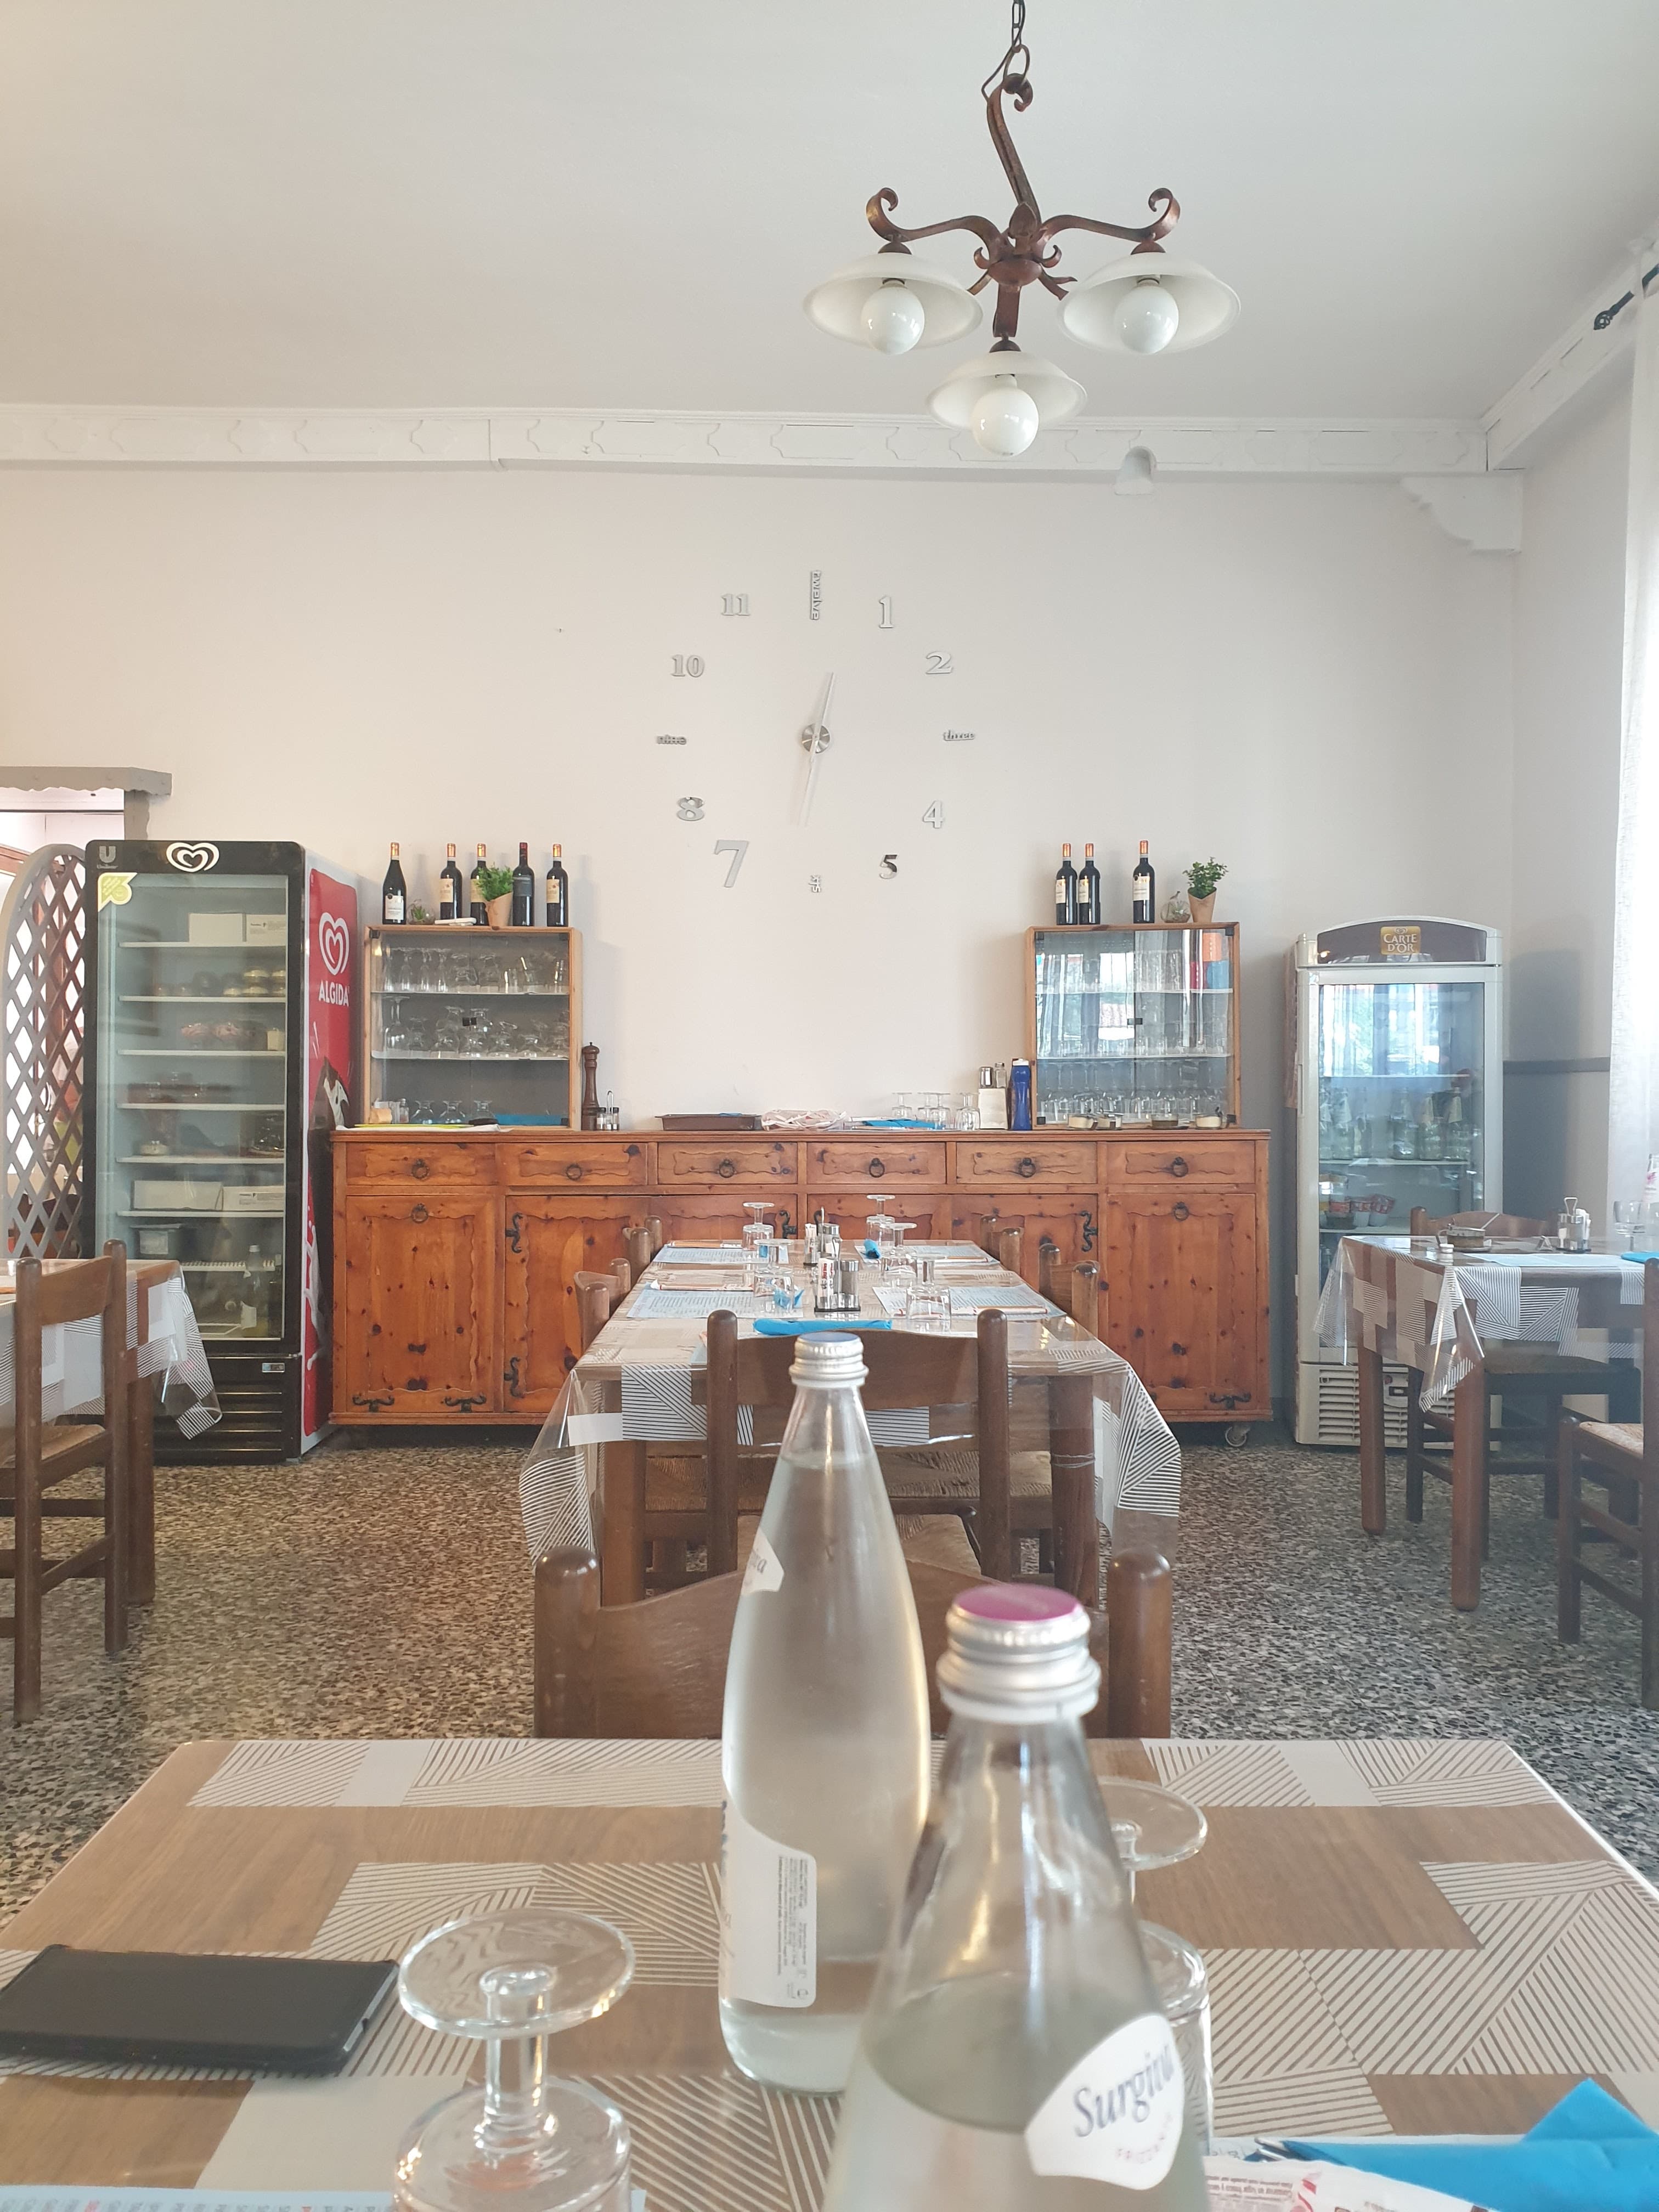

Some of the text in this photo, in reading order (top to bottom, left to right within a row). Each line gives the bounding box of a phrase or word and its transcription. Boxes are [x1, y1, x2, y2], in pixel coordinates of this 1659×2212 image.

[720, 594, 751, 616] 11
[810, 569, 822, 620] twelve
[878, 596, 894, 629] 1
[670, 654, 705, 678] 10
[926, 651, 953, 675] 2
[676, 797, 705, 822] 8
[922, 800, 945, 829] 4
[714, 839, 750, 888] 7
[879, 854, 898, 879] 5
[1383, 934, 1418, 944] CARTE
[1387, 943, 1414, 953] D'OR
[318, 979, 349, 1007] ALGIDA
